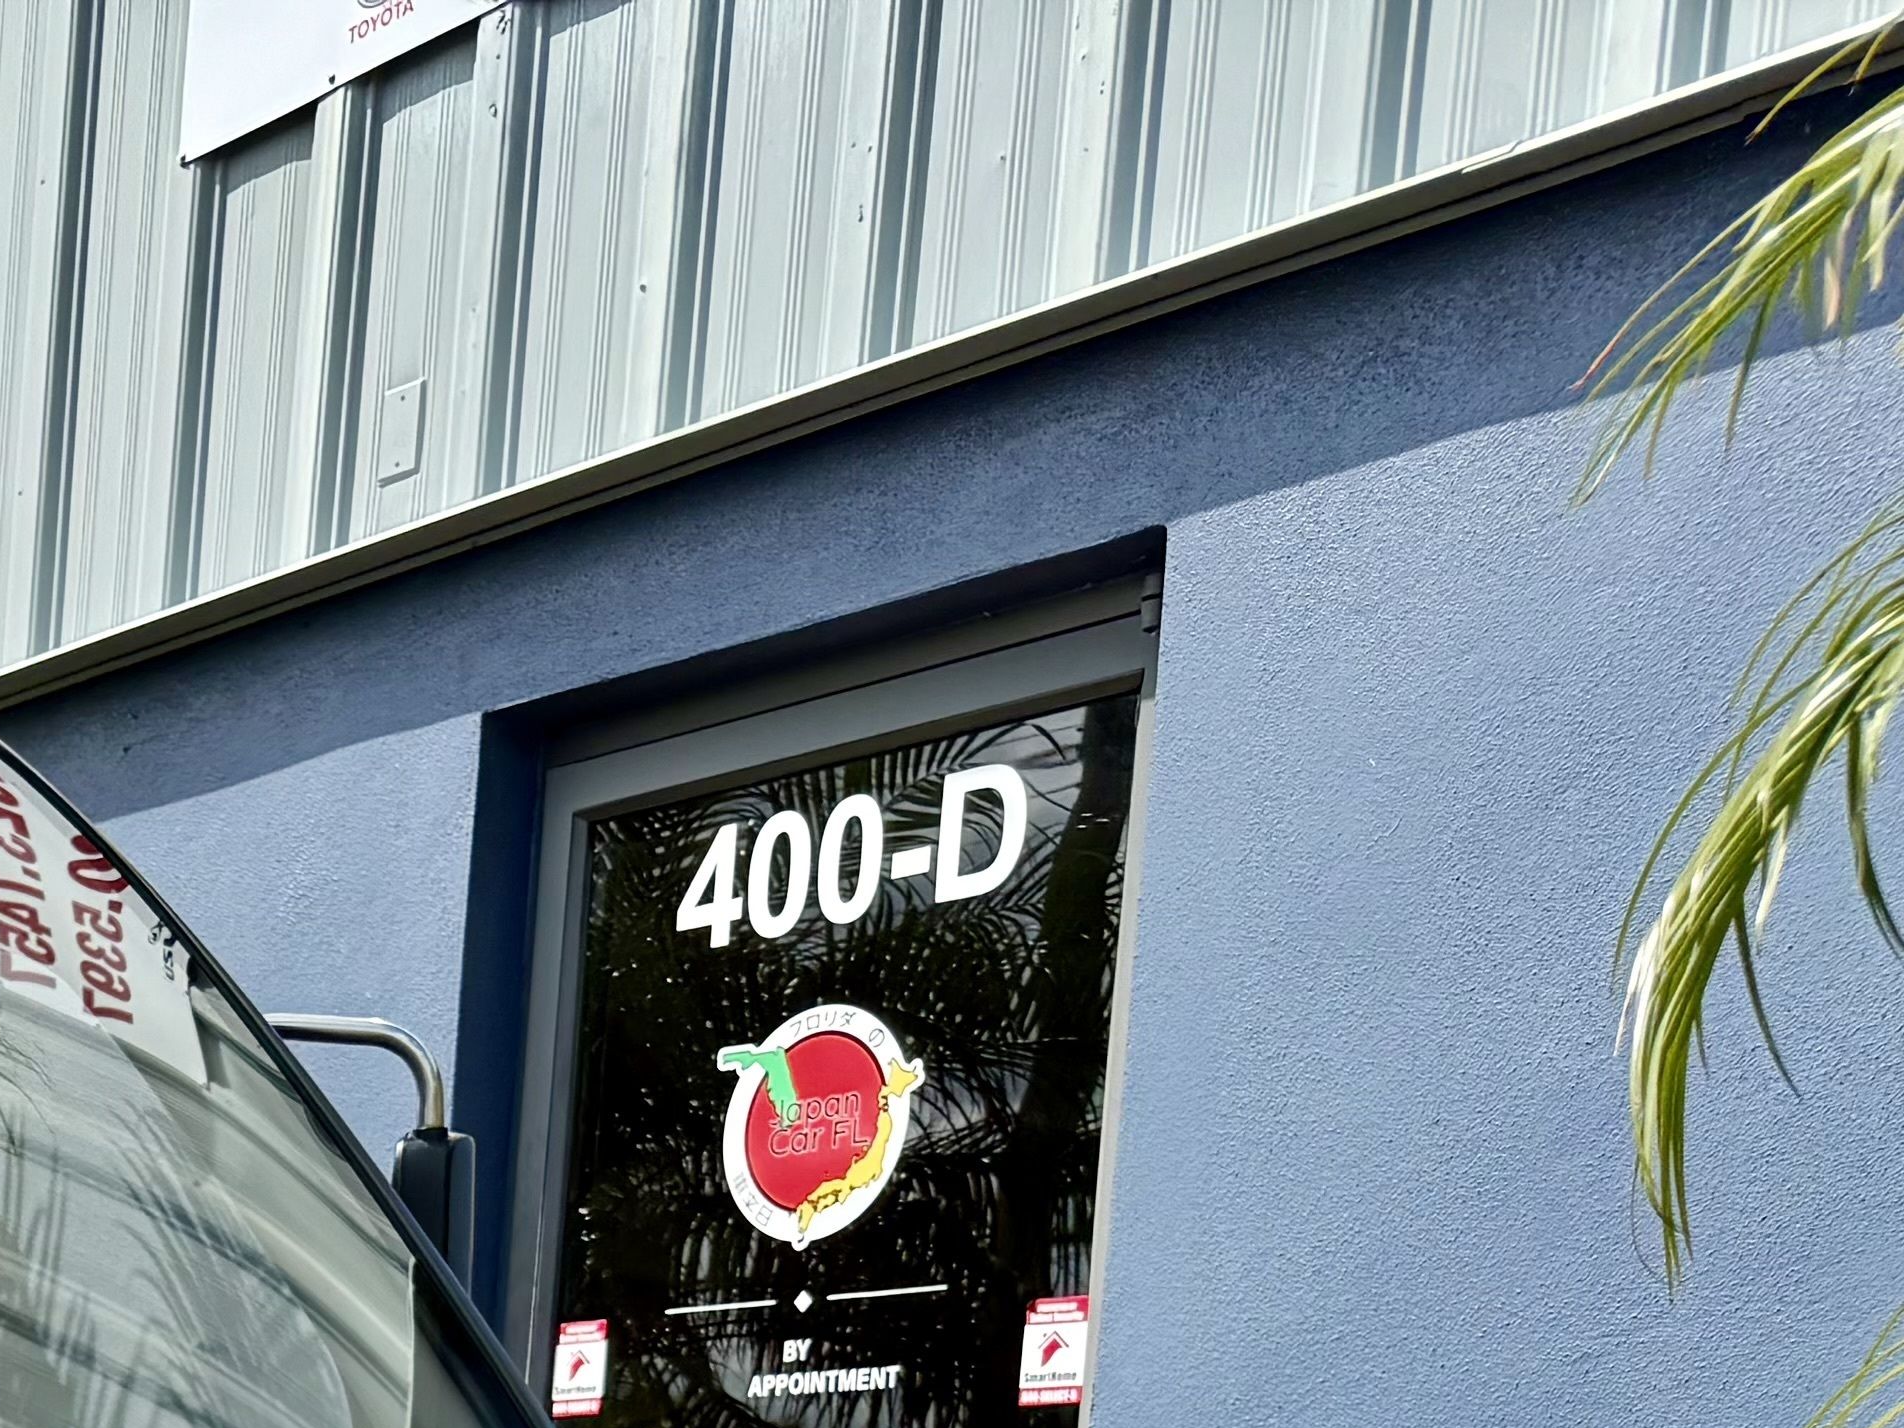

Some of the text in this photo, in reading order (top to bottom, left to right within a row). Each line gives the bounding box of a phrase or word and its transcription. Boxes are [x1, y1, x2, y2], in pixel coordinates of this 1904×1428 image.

[348, 0, 414, 44] TOYOTA
[675, 763, 1028, 949] 400-D
[789, 1010, 886, 1048] フロリダ の
[769, 1092, 860, 1129] Japan
[769, 1118, 869, 1156] Car FL
[782, 1338, 812, 1363] BY
[747, 1365, 901, 1397] APPOINTMENT
